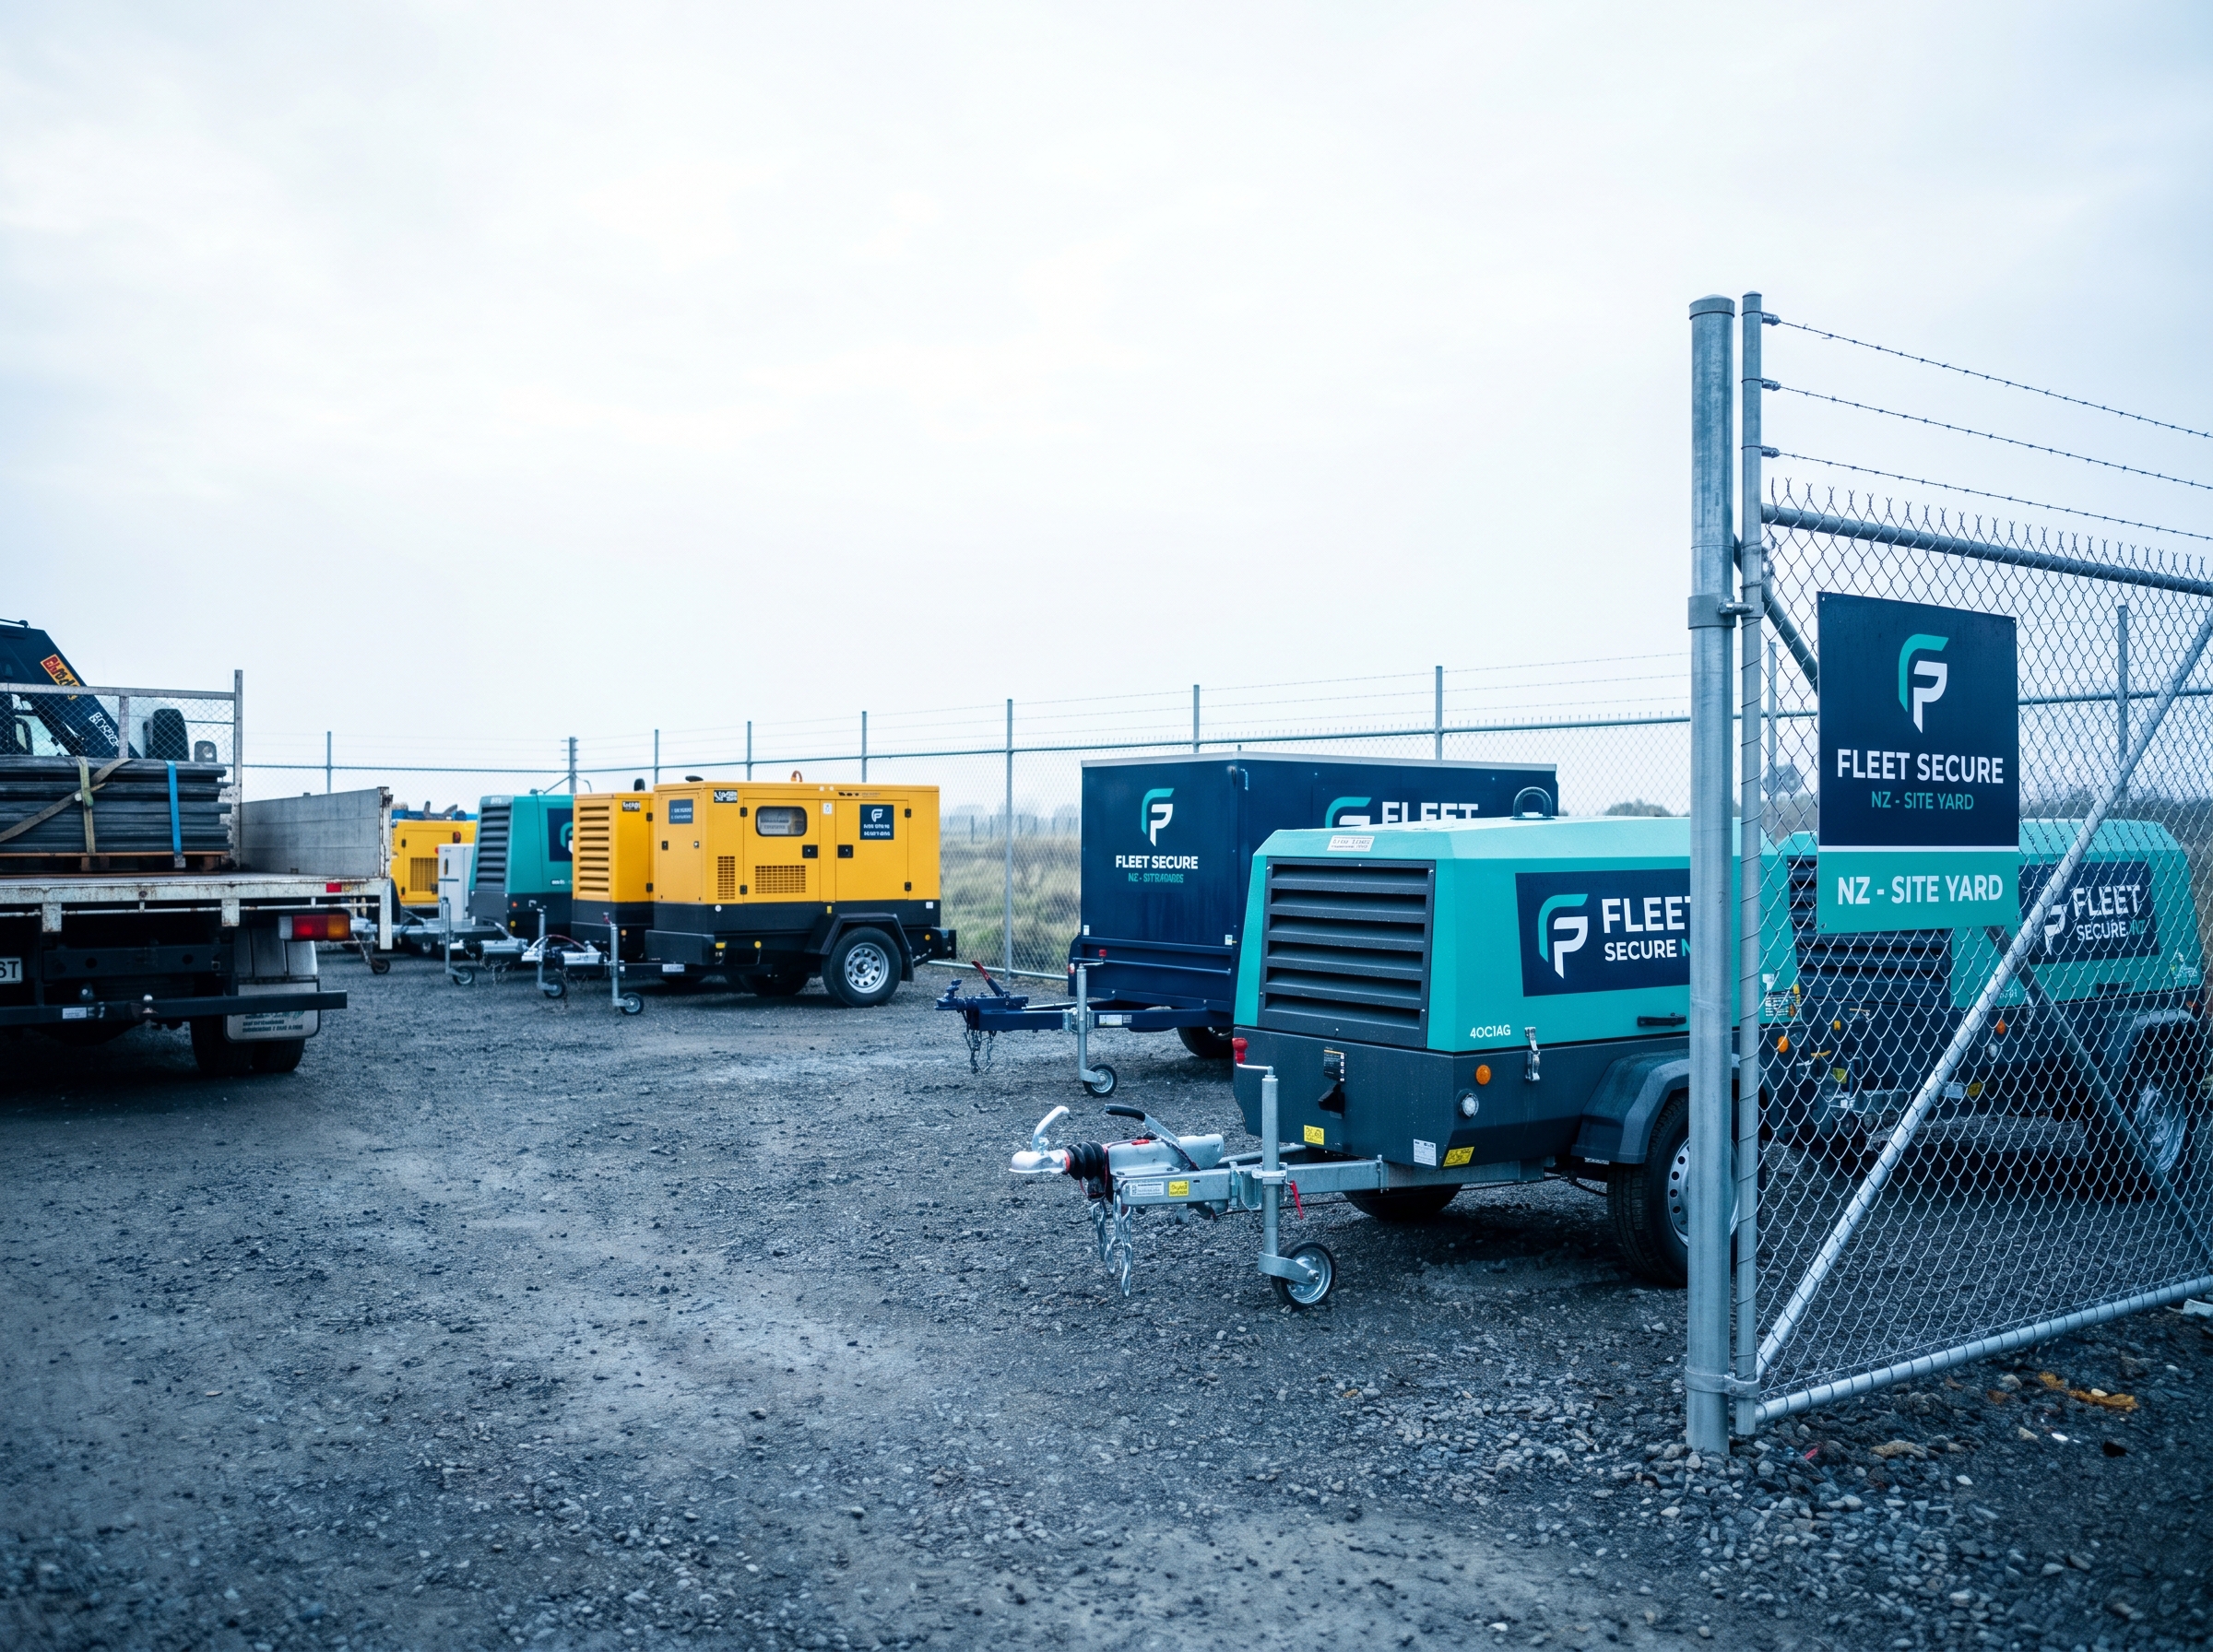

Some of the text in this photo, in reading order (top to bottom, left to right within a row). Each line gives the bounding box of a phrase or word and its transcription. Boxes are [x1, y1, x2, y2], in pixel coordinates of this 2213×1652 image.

[1837, 749, 2004, 784] FLEET SECURE
[1871, 791, 1891, 808] NZ
[1904, 792, 1934, 809] SITE
[1937, 793, 1974, 810] YARD
[1115, 855, 1199, 869] FLEET SECURE
[1838, 876, 1870, 905] NZ
[1891, 875, 1939, 904] SITE
[1946, 874, 2003, 902] YARD
[2073, 885, 2140, 917] FLEET
[2077, 920, 2128, 941] SECURE
[1604, 938, 1677, 962] SECURE
